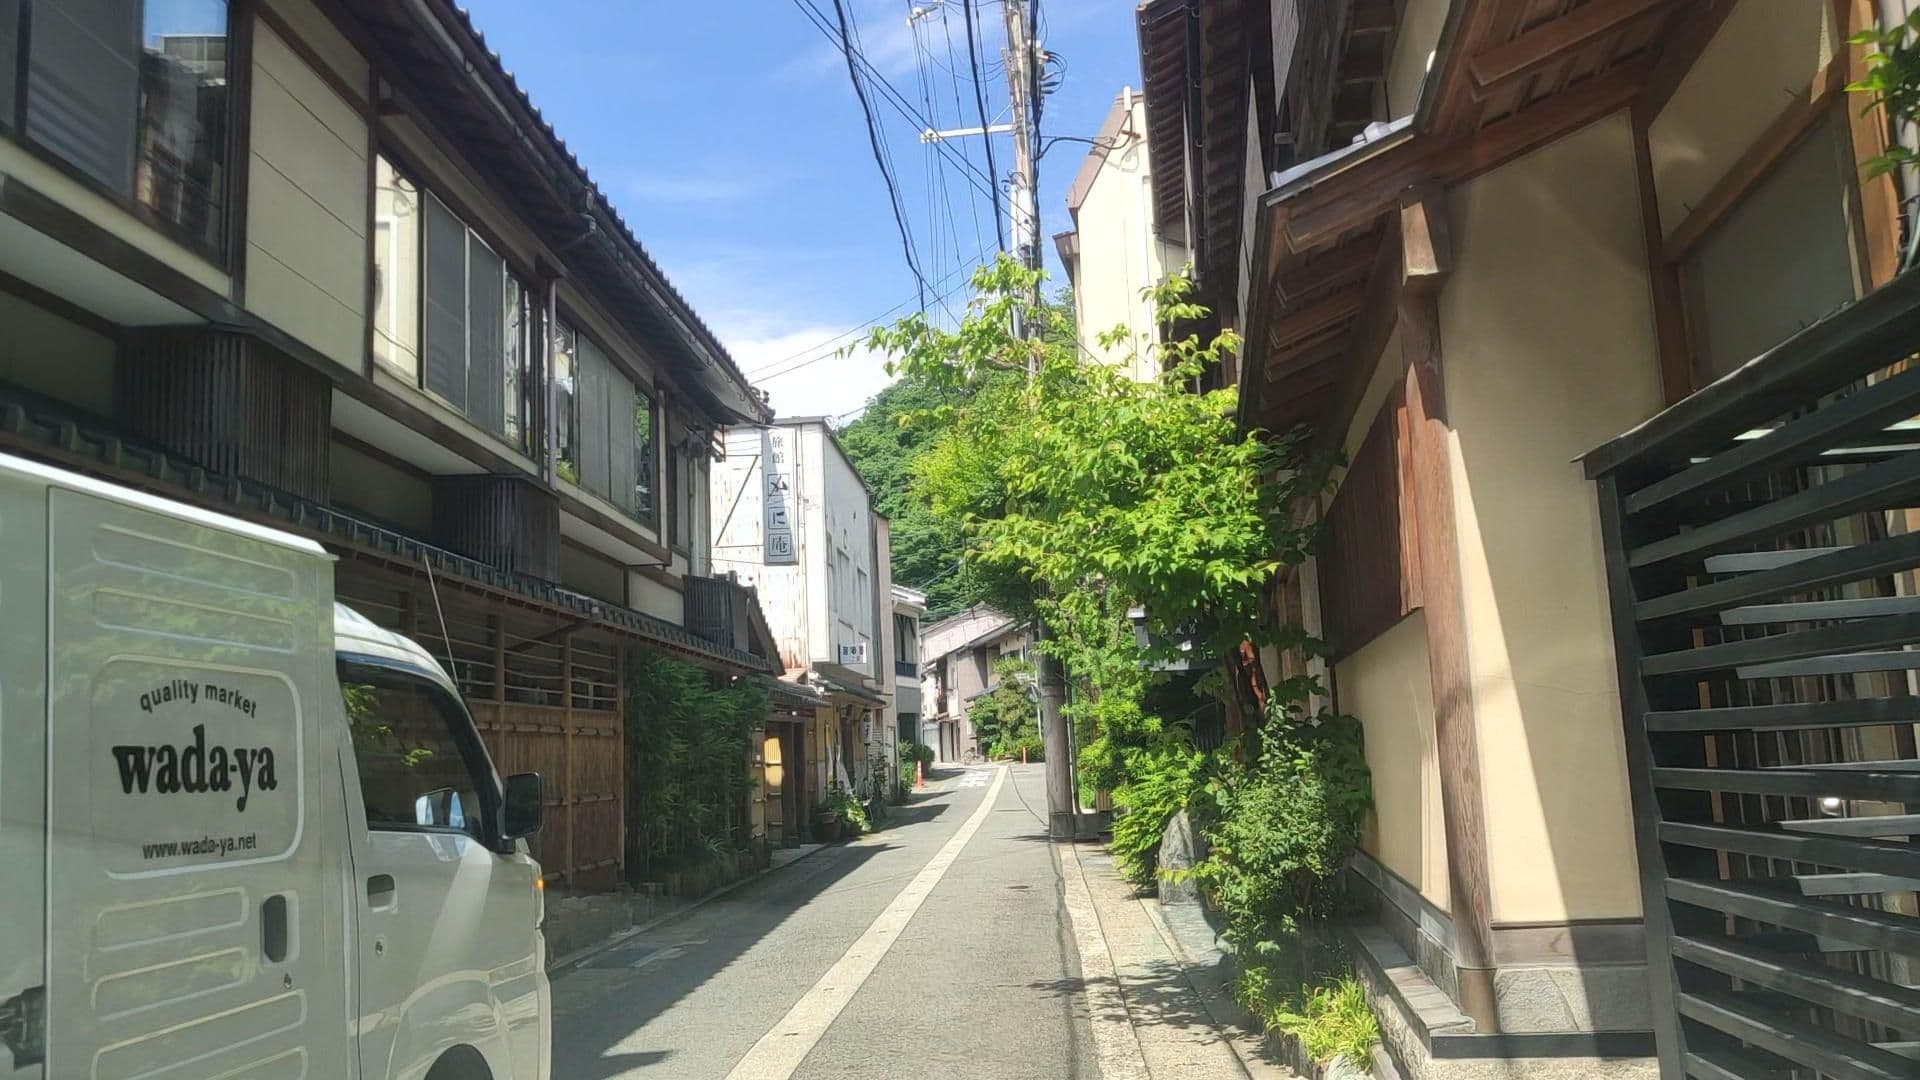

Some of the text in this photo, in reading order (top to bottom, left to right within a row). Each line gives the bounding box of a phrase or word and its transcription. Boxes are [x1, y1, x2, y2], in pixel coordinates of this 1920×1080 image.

[140, 679, 257, 718] quality market
[112, 723, 278, 812] wada-ya
[142, 832, 257, 859] www.wada-ya.net
